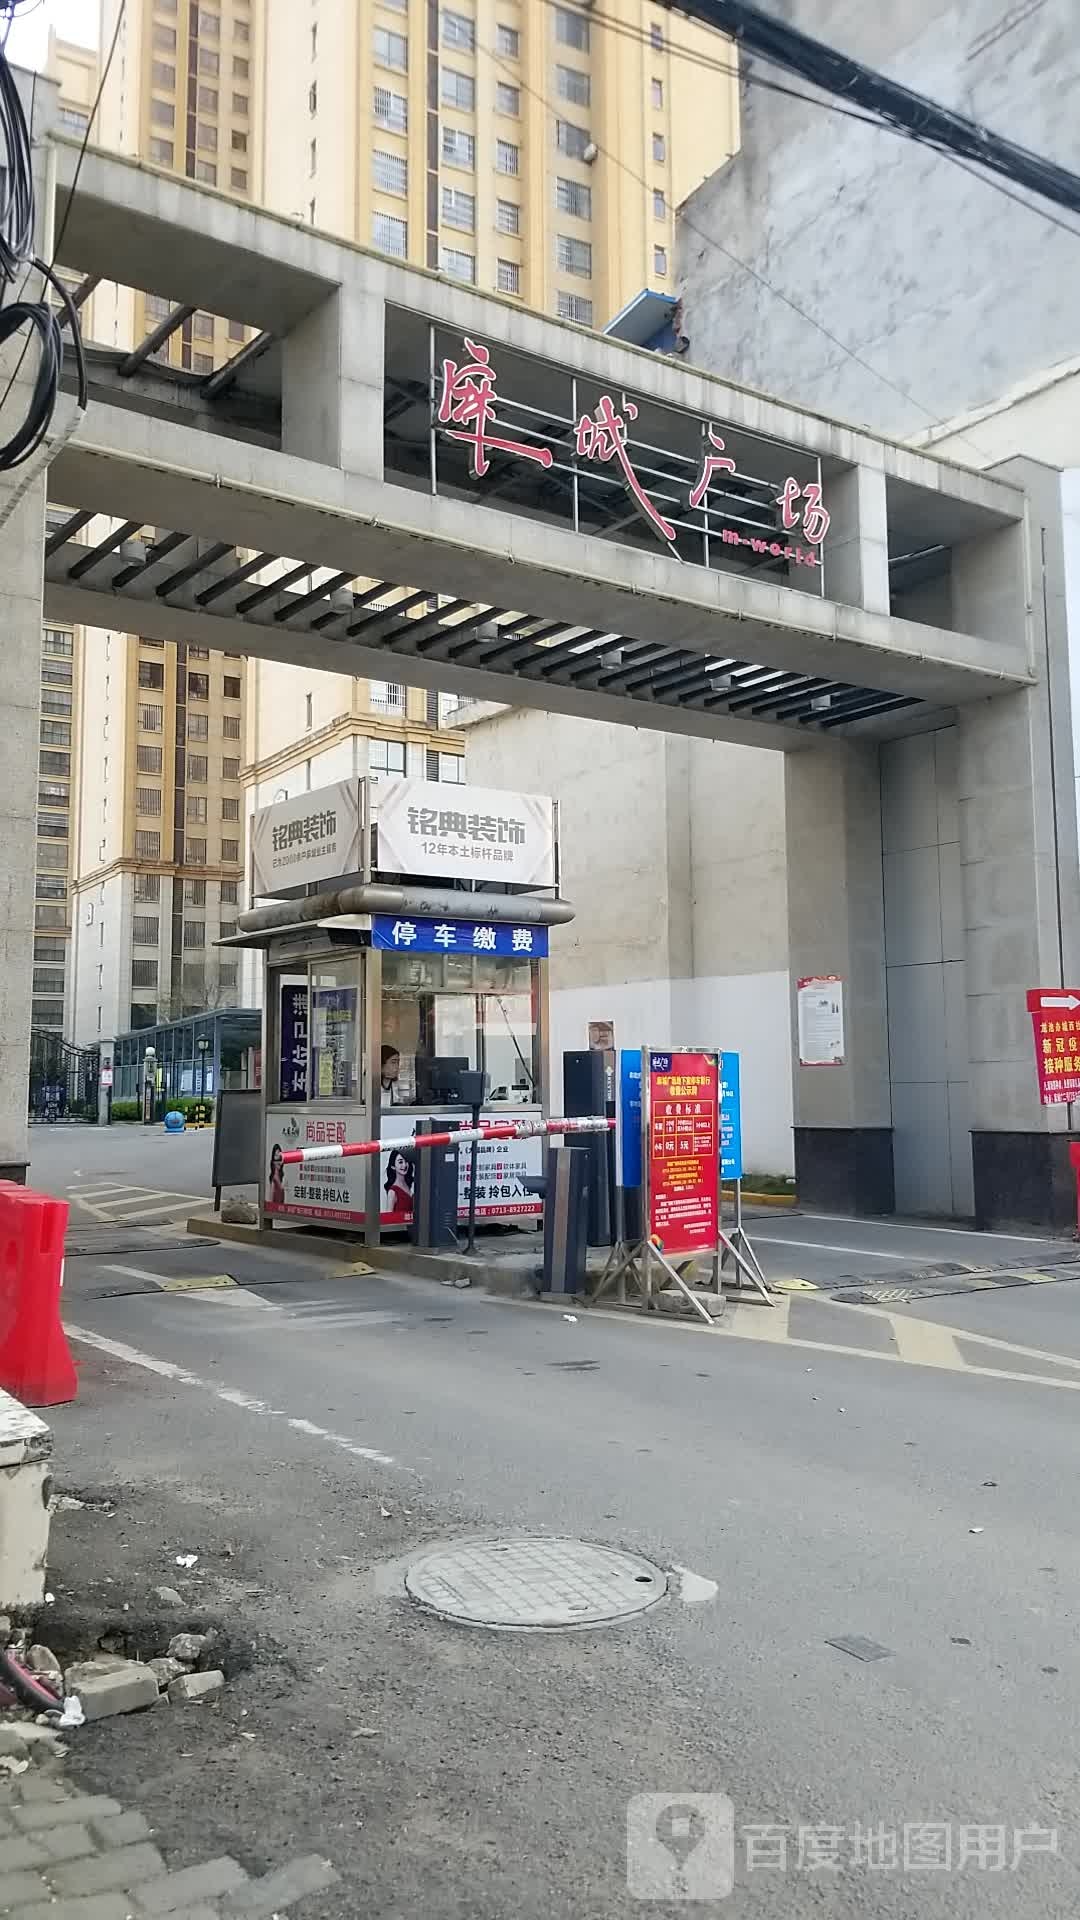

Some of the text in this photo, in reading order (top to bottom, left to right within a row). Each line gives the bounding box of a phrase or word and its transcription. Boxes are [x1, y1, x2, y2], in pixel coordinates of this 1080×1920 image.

[439, 336, 831, 545] 麻城广场
[722, 529, 817, 568] m-world
[271, 810, 337, 852] 铭典装饰
[407, 806, 526, 845] 铭典装饰
[420, 840, 515, 863] 12年本土标杆品牌
[391, 920, 533, 952] 停车缴费
[1042, 1037, 1078, 1054] 新冠疫
[306, 1121, 347, 1143] 尚品宅配
